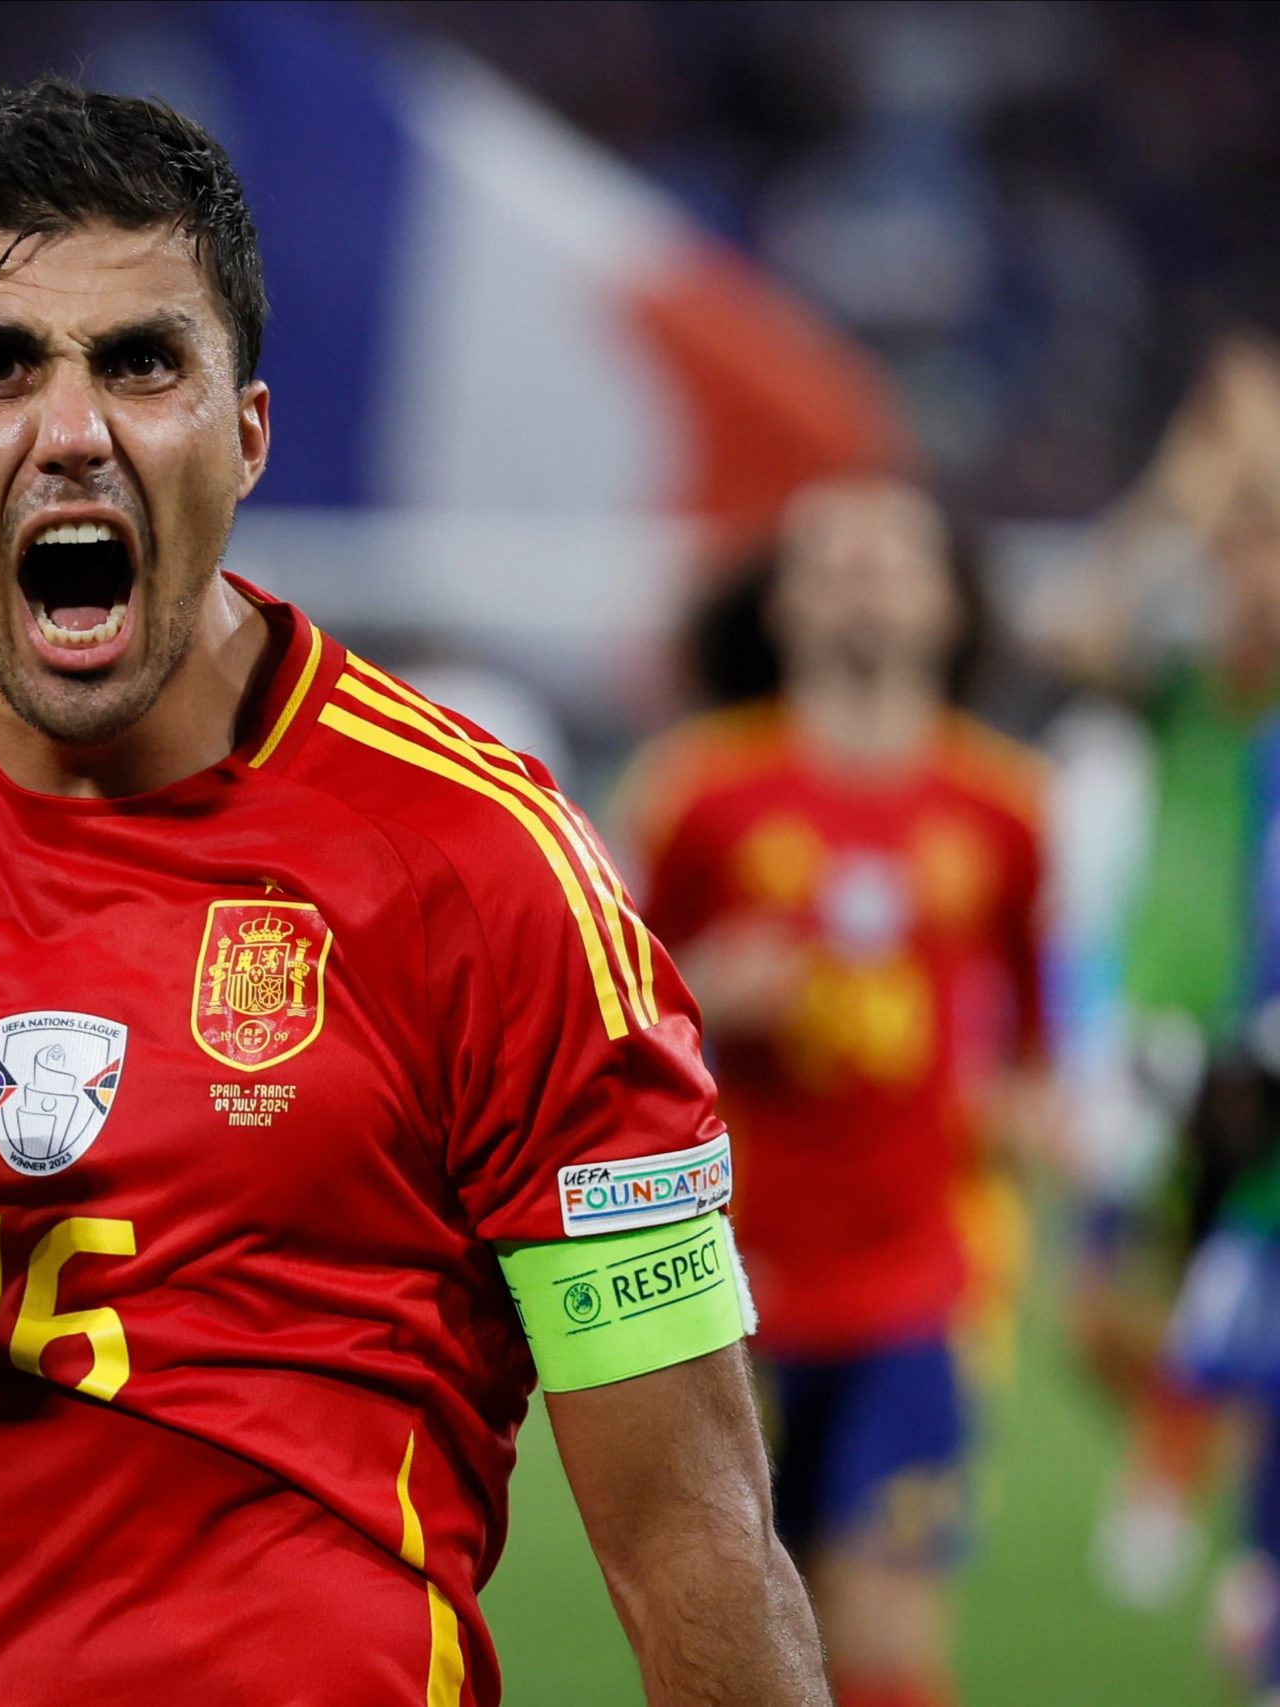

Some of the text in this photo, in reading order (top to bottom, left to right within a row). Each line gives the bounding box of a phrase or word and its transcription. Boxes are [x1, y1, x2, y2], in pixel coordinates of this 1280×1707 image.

[2, 1017, 120, 1038] UEFA NATIONS LEAGUE
[209, 1084, 240, 1097] SPAIN
[254, 1084, 296, 1098] FRANCE
[214, 1099, 288, 1112] 09 JULY 2024
[228, 1113, 272, 1126] MUNICH
[10, 1151, 72, 1171] WINNER 2023
[564, 1167, 611, 1186] UEFA
[565, 1156, 729, 1212] FOUNDATION
[612, 1239, 720, 1308] RESPECT
